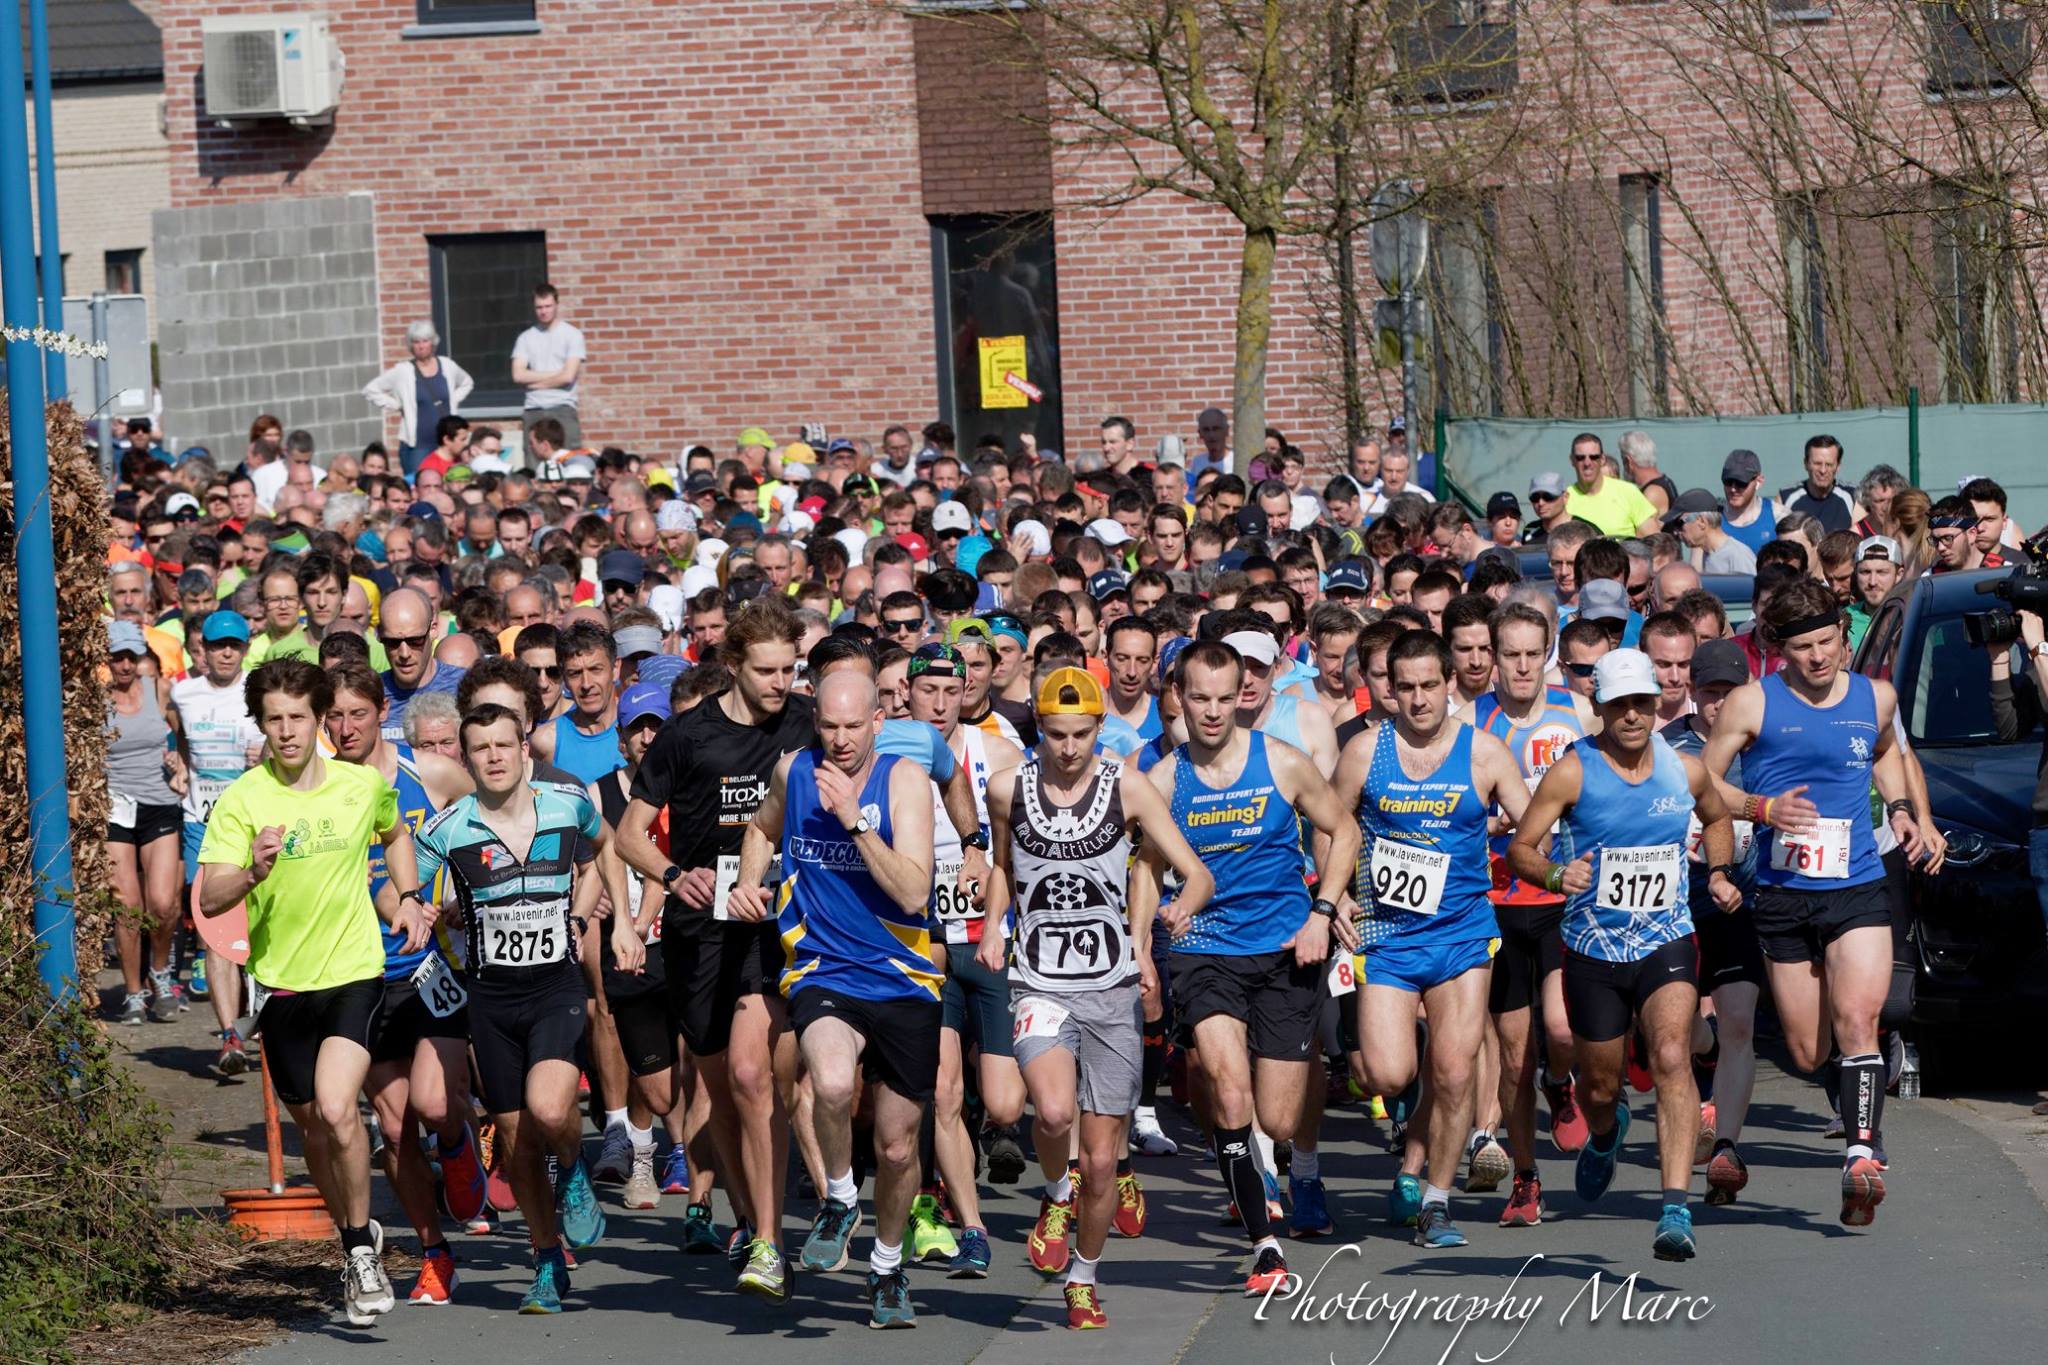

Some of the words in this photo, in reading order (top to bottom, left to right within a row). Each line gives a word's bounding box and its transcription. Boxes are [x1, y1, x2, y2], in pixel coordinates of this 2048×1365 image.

[728, 774, 757, 784] BELGIUM
[719, 813, 739, 823] MORE
[1187, 796, 1268, 827] training7
[1379, 792, 1461, 817] training7
[1015, 821, 1046, 857] Run
[1047, 822, 1118, 860] Attitude
[533, 863, 558, 873] wallon
[1379, 843, 1444, 869] www.lavenir.net
[1606, 848, 1675, 864] www.lavenir.net
[1784, 841, 1825, 872] 761
[1838, 846, 1848, 863] 761
[1376, 865, 1428, 908] 920
[1609, 872, 1667, 908] 3172
[488, 905, 559, 922] www.lavenir.net
[494, 927, 555, 964] 2875
[1045, 930, 1100, 970] 79
